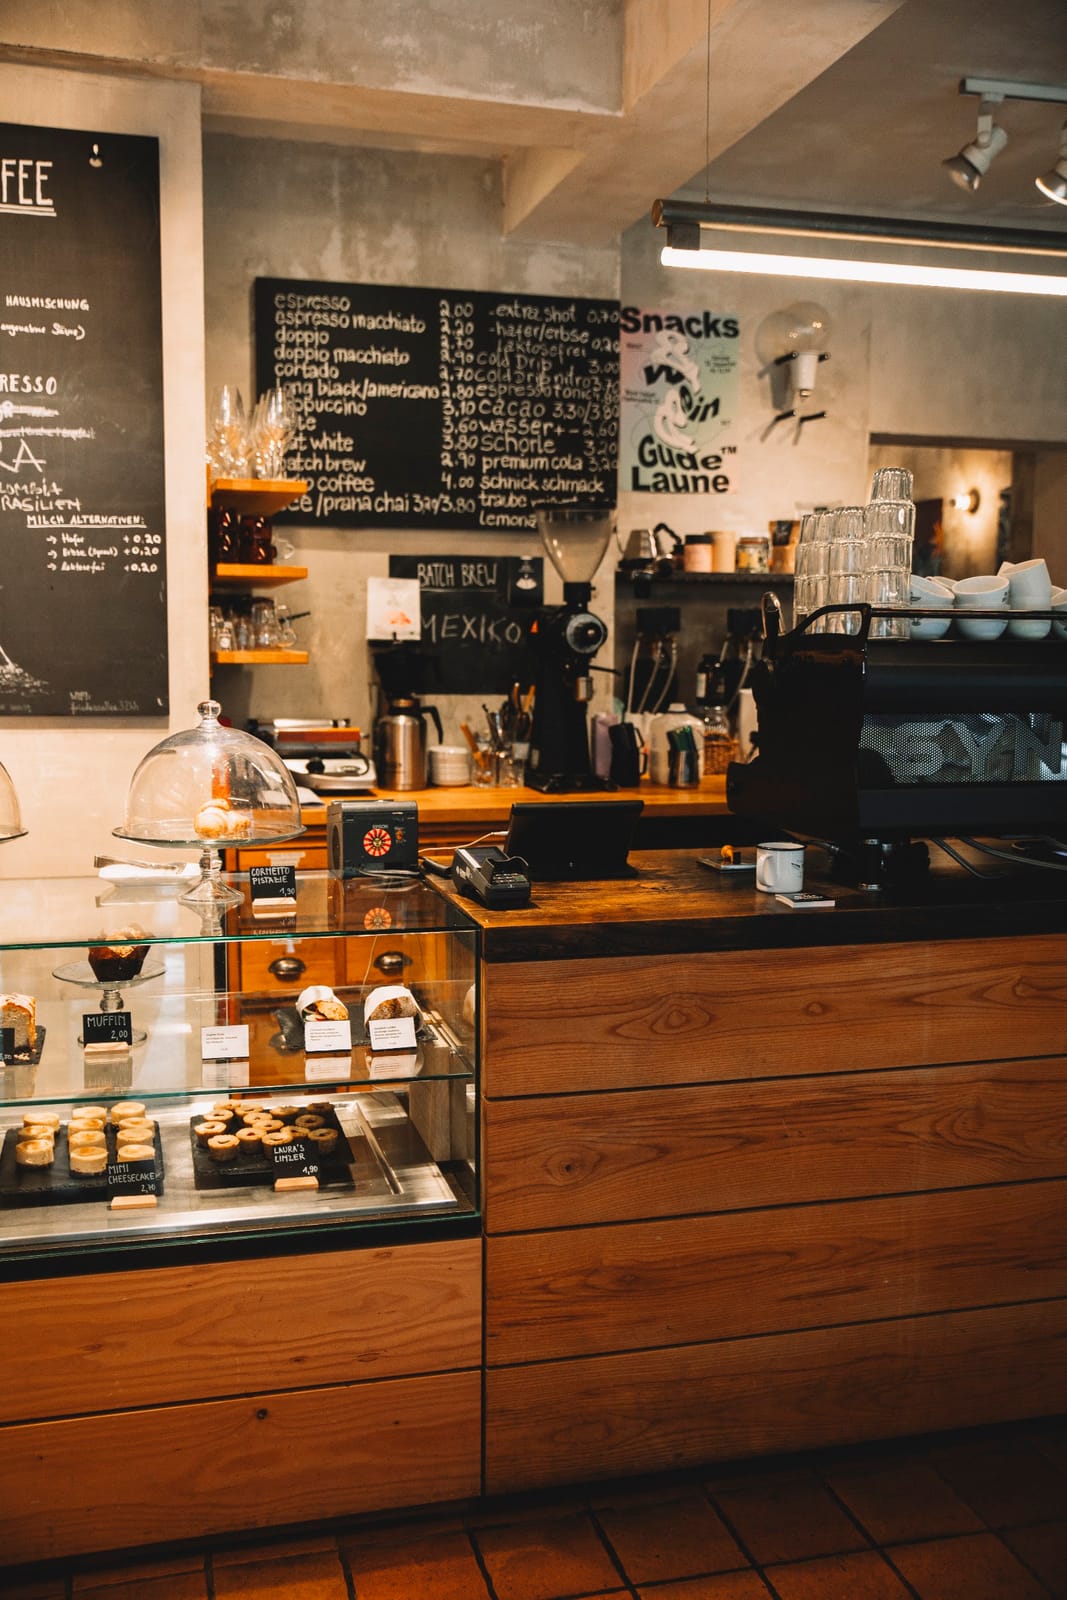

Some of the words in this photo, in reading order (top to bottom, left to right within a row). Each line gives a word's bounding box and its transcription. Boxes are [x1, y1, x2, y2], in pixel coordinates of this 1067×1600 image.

[5, 294, 90, 311] HAUSMISCHUNG
[274, 293, 351, 314] espresso
[543, 303, 576, 323] shot
[275, 308, 350, 329] espresso
[352, 310, 426, 334] macchiato
[620, 305, 740, 340] Snacks
[275, 325, 330, 347] doppio
[274, 343, 330, 365] doppio
[333, 344, 410, 367] macchiato
[274, 362, 340, 379] cortado
[317, 376, 440, 401] black/americano
[478, 399, 546, 418] cacao
[479, 417, 554, 437] wasser
[309, 430, 354, 453] white
[325, 453, 366, 473] brew
[482, 453, 549, 475] premium
[550, 453, 583, 472] cola
[317, 473, 375, 493] coffee
[480, 471, 540, 492] schnick
[541, 473, 605, 494] schmack
[631, 465, 730, 494] Laune
[374, 490, 410, 513] chai
[478, 490, 527, 508] traube
[26, 514, 65, 526] MILCH
[479, 509, 538, 530] lemona
[417, 562, 455, 588] BATCH
[460, 562, 498, 587] BREW
[421, 613, 522, 645] MEXIKO
[87, 1015, 127, 1028] MUFFIN
[110, 1030, 129, 1041] 2,00
[273, 1143, 305, 1155] LAURA'S
[108, 1163, 130, 1175] MINI
